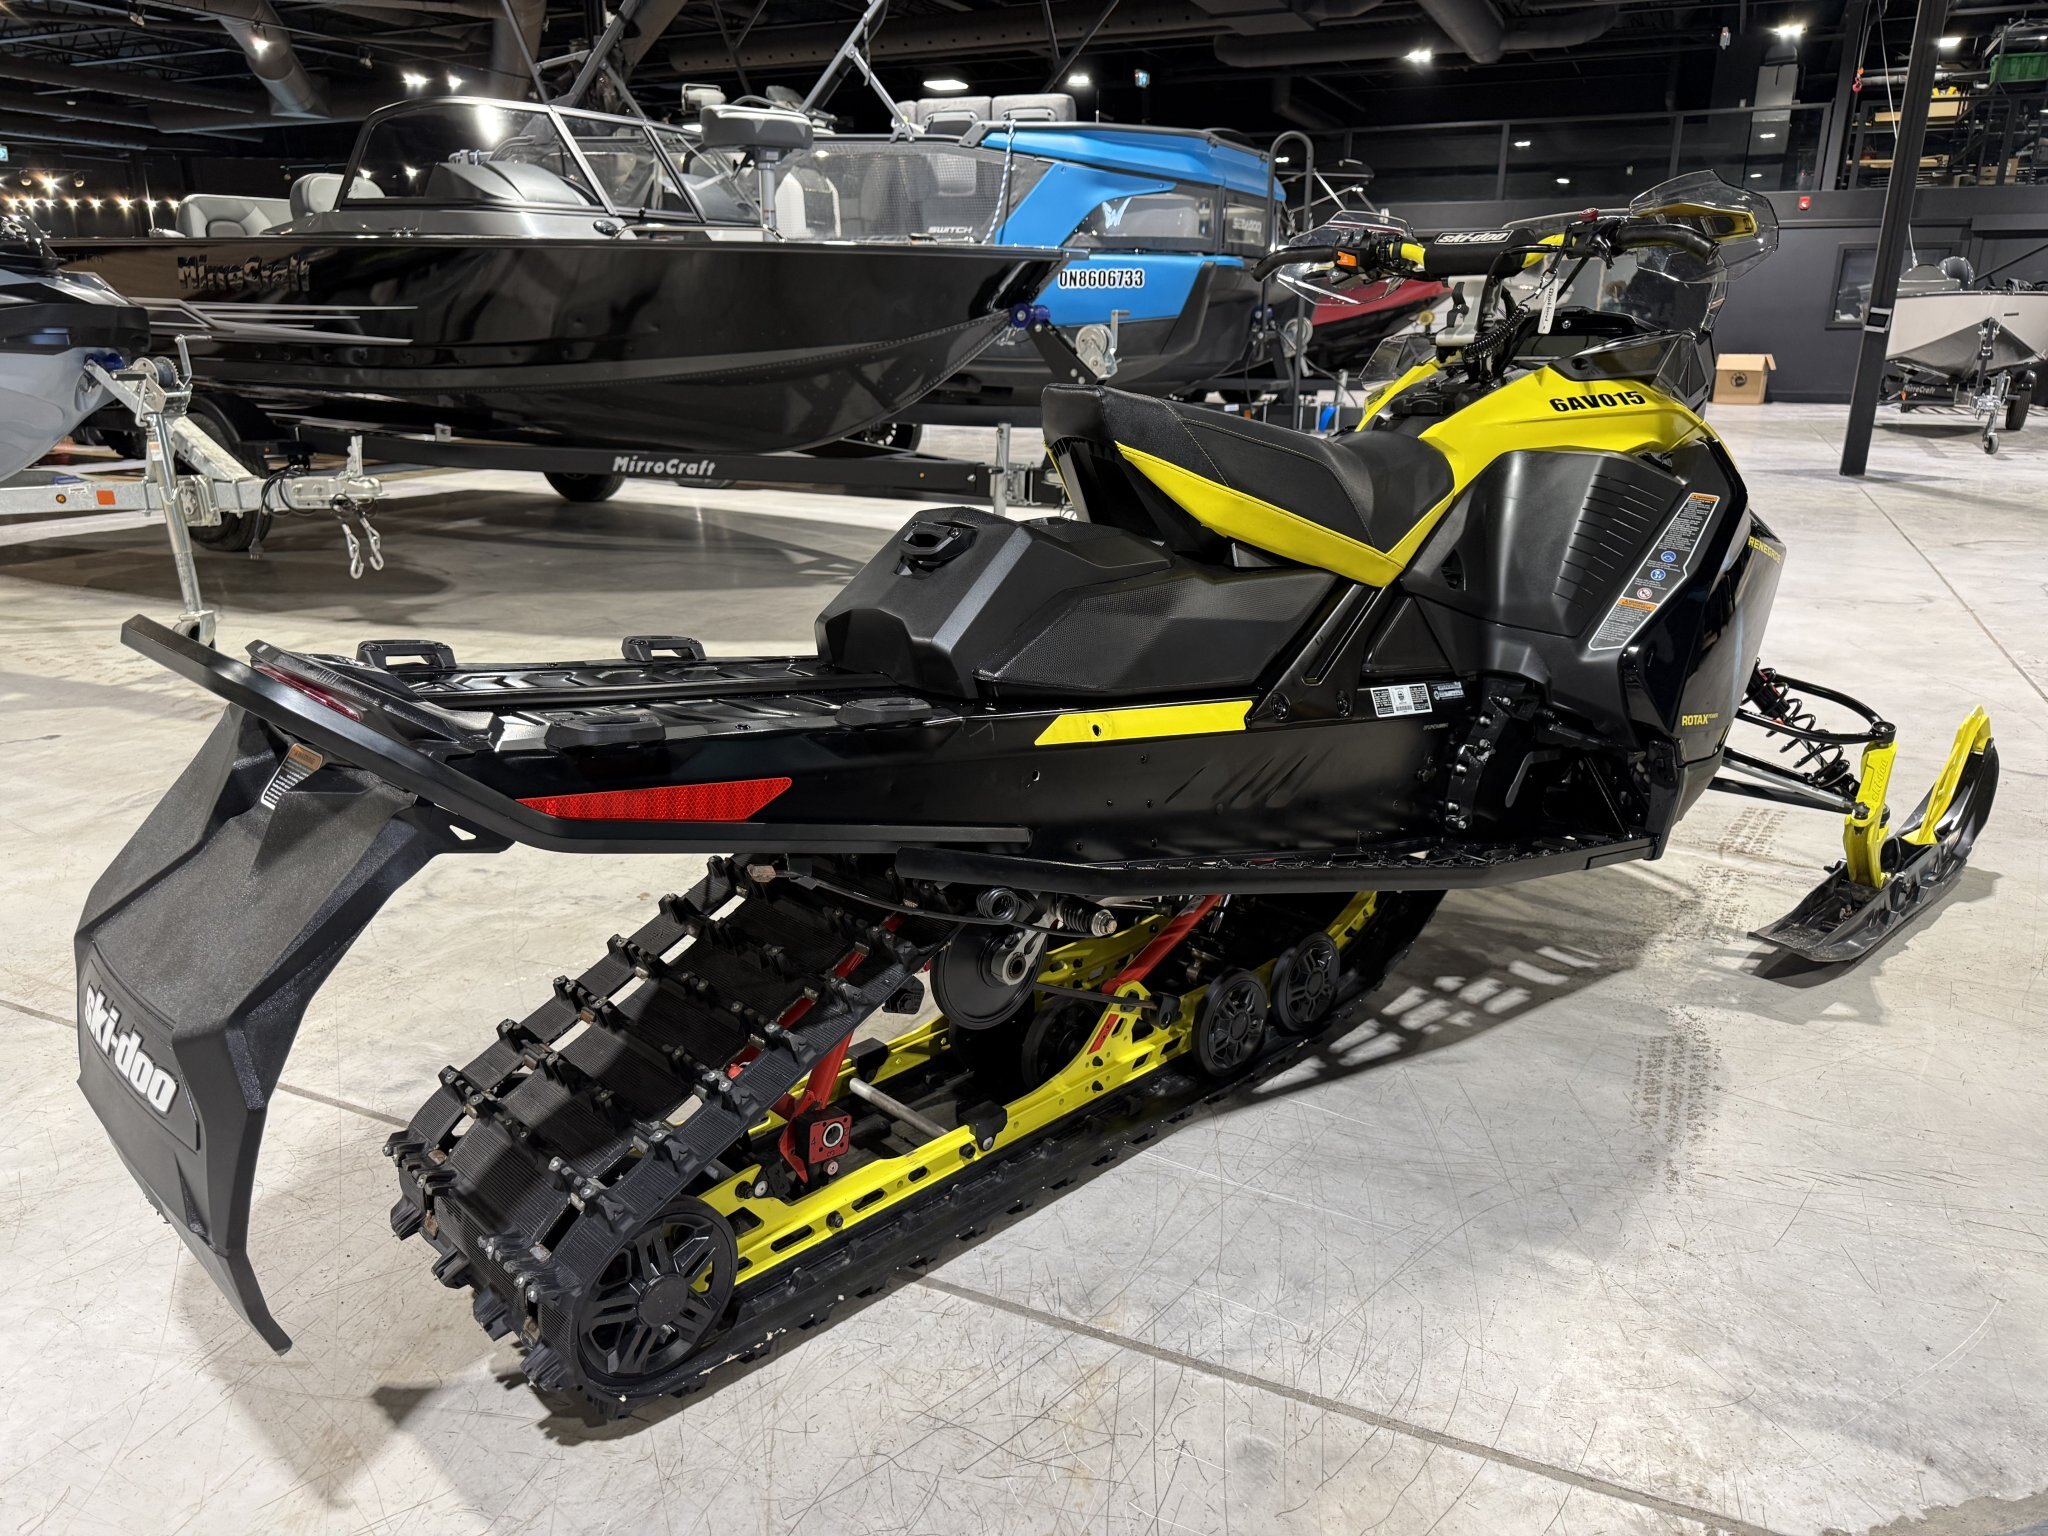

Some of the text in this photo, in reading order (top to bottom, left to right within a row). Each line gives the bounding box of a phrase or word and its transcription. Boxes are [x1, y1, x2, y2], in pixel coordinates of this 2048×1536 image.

[927, 225, 974, 234] SWITCH
[1437, 232, 1510, 243] ski-doo
[1058, 269, 1144, 288] ON8606733
[612, 455, 716, 476] MirroCraft
[1681, 714, 1709, 727] ROTAX
[84, 983, 178, 1113] ski-doo
